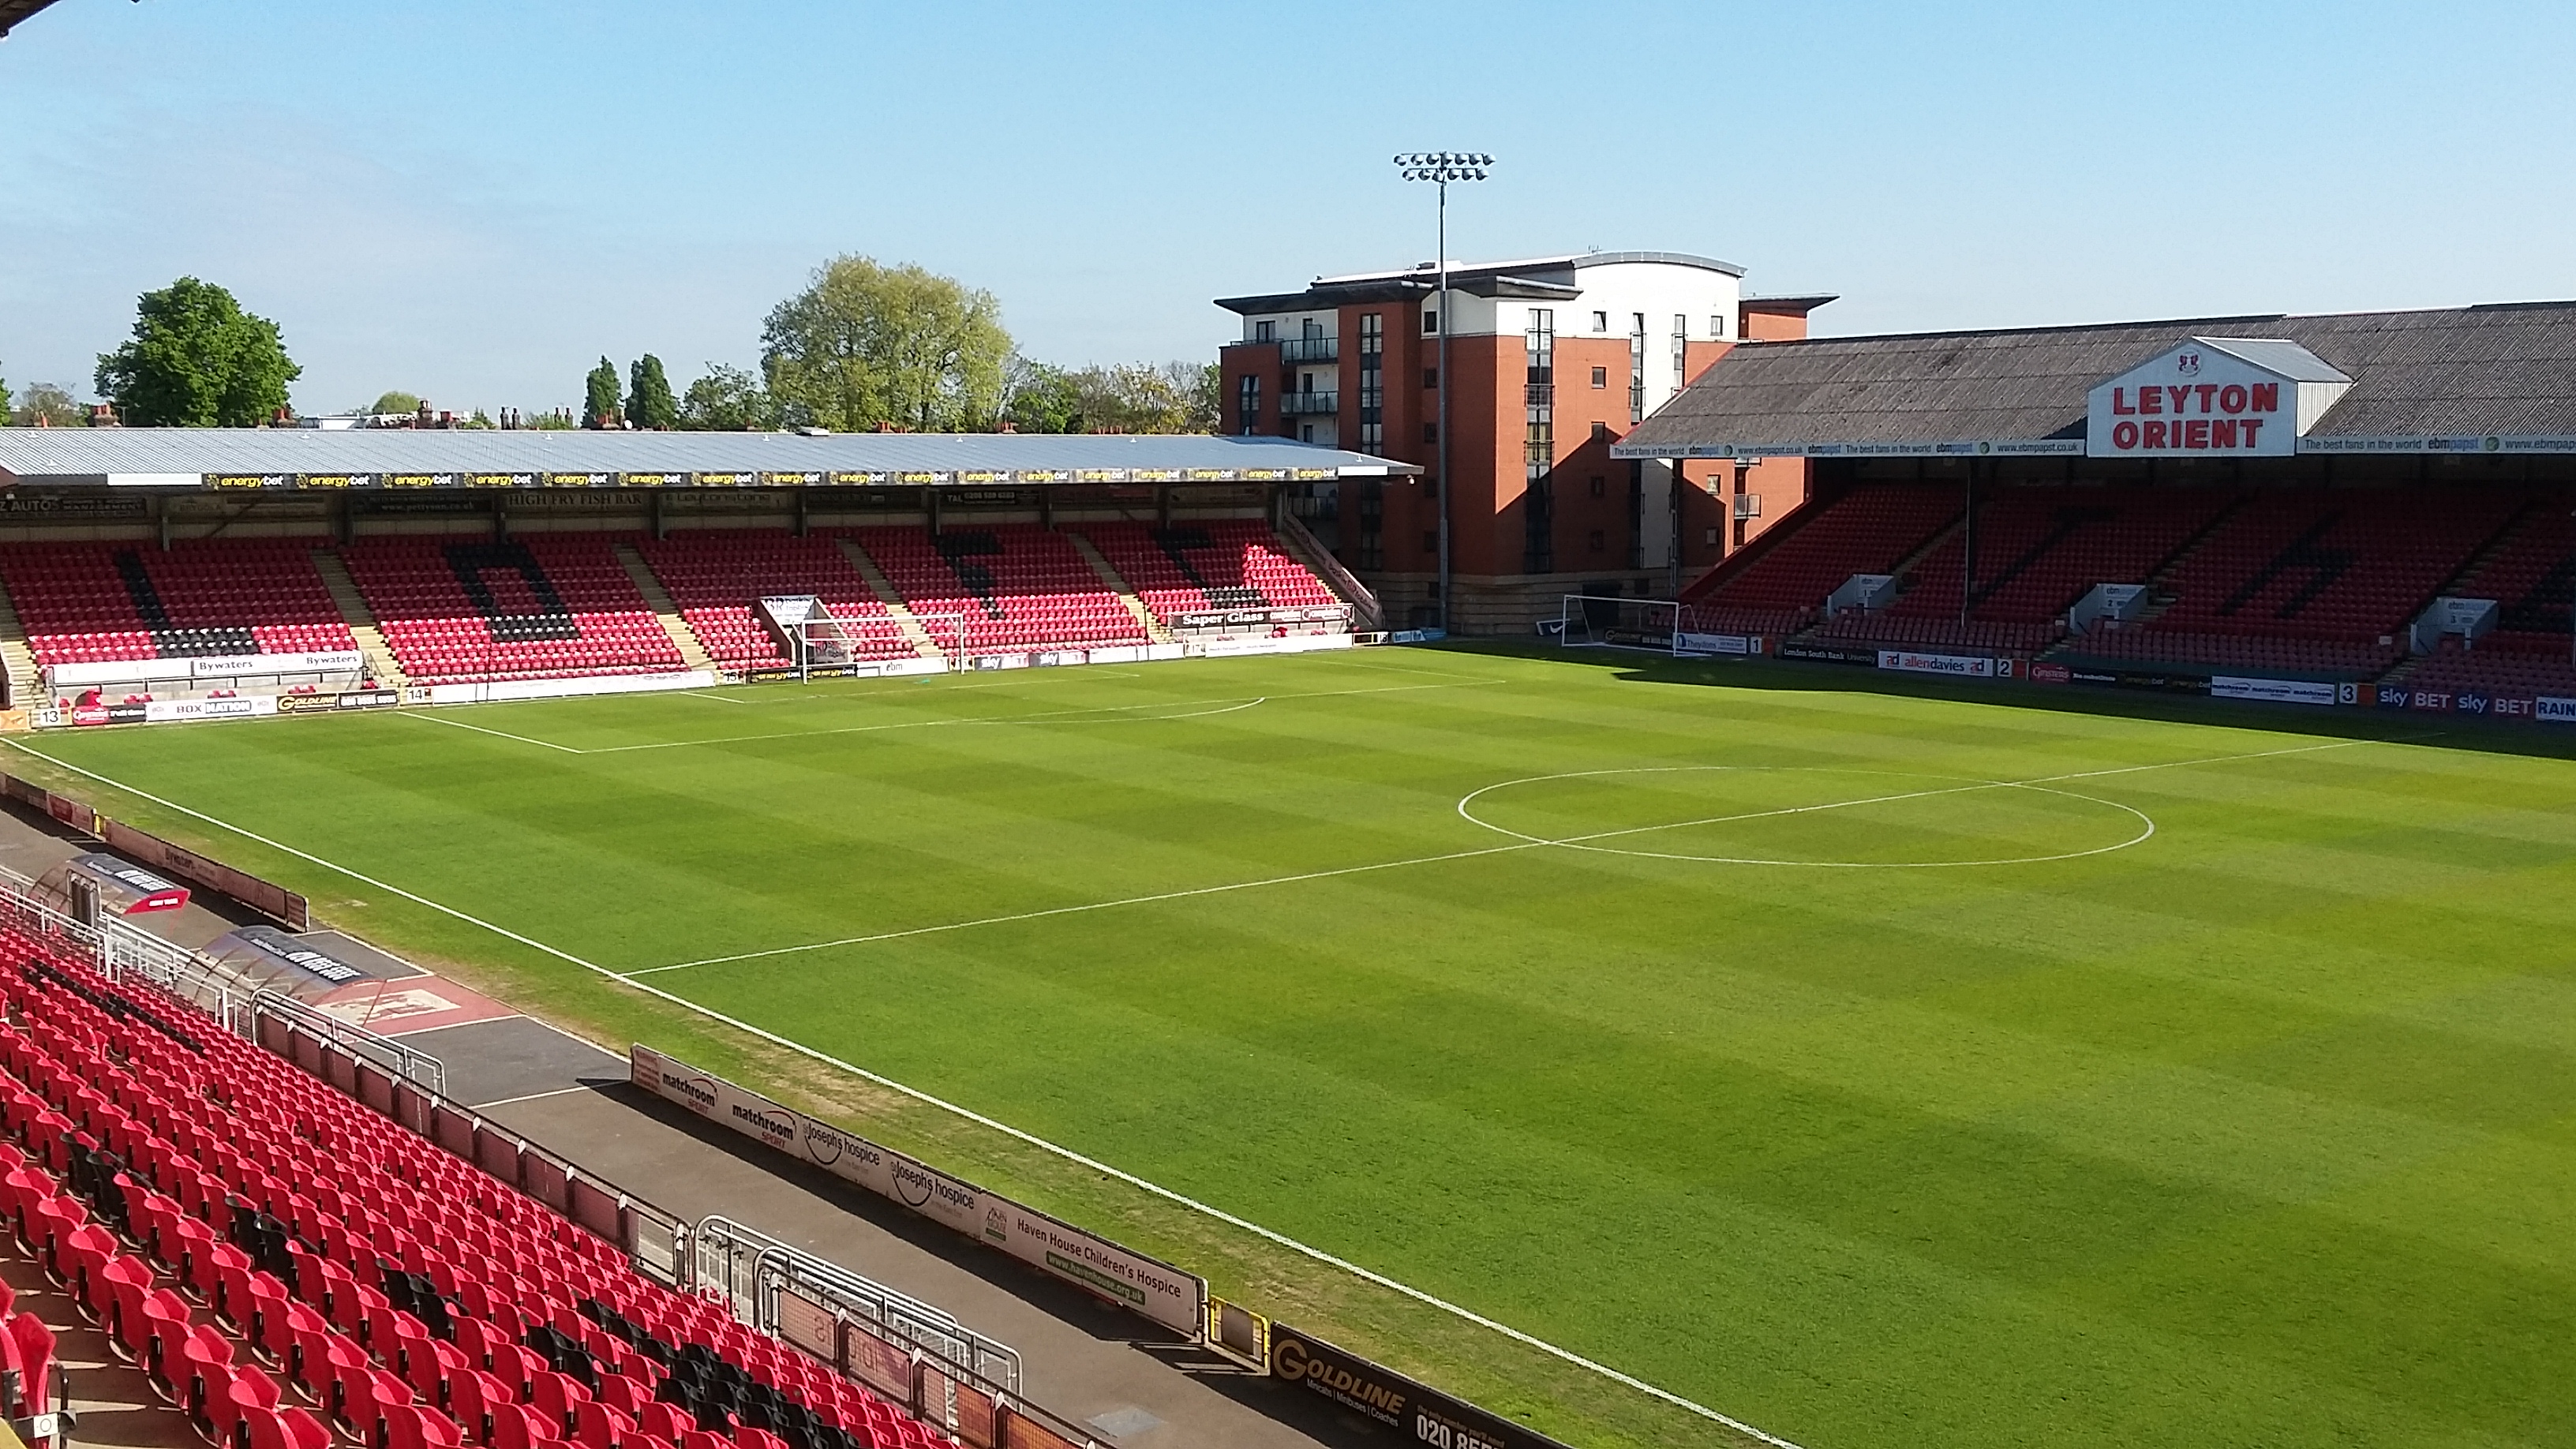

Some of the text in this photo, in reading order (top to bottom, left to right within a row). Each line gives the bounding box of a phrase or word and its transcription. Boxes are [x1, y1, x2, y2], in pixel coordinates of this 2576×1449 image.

[2113, 382, 2279, 416] LEYTON
[2112, 418, 2265, 450] ORIENT
[1614, 447, 1684, 455] The best fans in the world
[1738, 445, 1803, 456] www.ebmpapst.co.uk
[1846, 444, 1931, 454] The best fans in the world
[1997, 442, 2077, 455] www.ebmpapst.co.uk
[2305, 440, 2421, 449] The best fans in the world
[221, 475, 283, 487] energybet
[309, 474, 369, 487] energybet
[395, 474, 452, 486] energybet
[476, 474, 532, 485] energybet
[554, 474, 607, 485] energybet
[630, 474, 681, 485] energybet
[702, 474, 753, 485] energybet
[773, 473, 820, 484] energybet
[840, 473, 886, 483] energybet
[11, 500, 60, 511] AUTOS
[509, 495, 548, 505] HIGH
[580, 494, 611, 504] FISH
[616, 494, 642, 504] BAR
[1183, 611, 1264, 627] Saper Glass
[1753, 639, 1759, 652] 1
[200, 656, 358, 671] Bywaters Bywaters
[981, 656, 1000, 669] sky
[1040, 653, 1058, 667] sky
[1784, 649, 1875, 665] London South Bank University
[1887, 653, 1985, 672] ad allendavies ad
[2000, 661, 2009, 676] 2
[725, 672, 737, 682] 15
[409, 690, 422, 700] 14
[2342, 685, 2353, 702] 3
[176, 705, 202, 713] BOX
[206, 702, 250, 713] NATION
[278, 696, 337, 710] GOLDLINE
[2379, 687, 2533, 715] sky BET sky BET
[42, 710, 58, 723] 13
[2538, 702, 2576, 717] RAIN
[662, 1071, 716, 1107] matchroom
[687, 1098, 710, 1115] SPORT
[732, 1103, 794, 1140] matchroom
[762, 1131, 786, 1148] SPORT
[807, 1123, 843, 1151] Joseph's
[844, 1136, 880, 1166] hospice
[896, 1160, 934, 1191] Joseph's
[935, 1181, 975, 1210] hospice
[1017, 1218, 1181, 1298] Haven House Children's Hospice
[1048, 1253, 1144, 1302] www.havenhouse.org.uk
[1273, 1339, 1406, 1416] GOLDLINE
[1307, 1378, 1398, 1428] Minicabs Minibuses Coaches
[1417, 1414, 1451, 1449] 020
